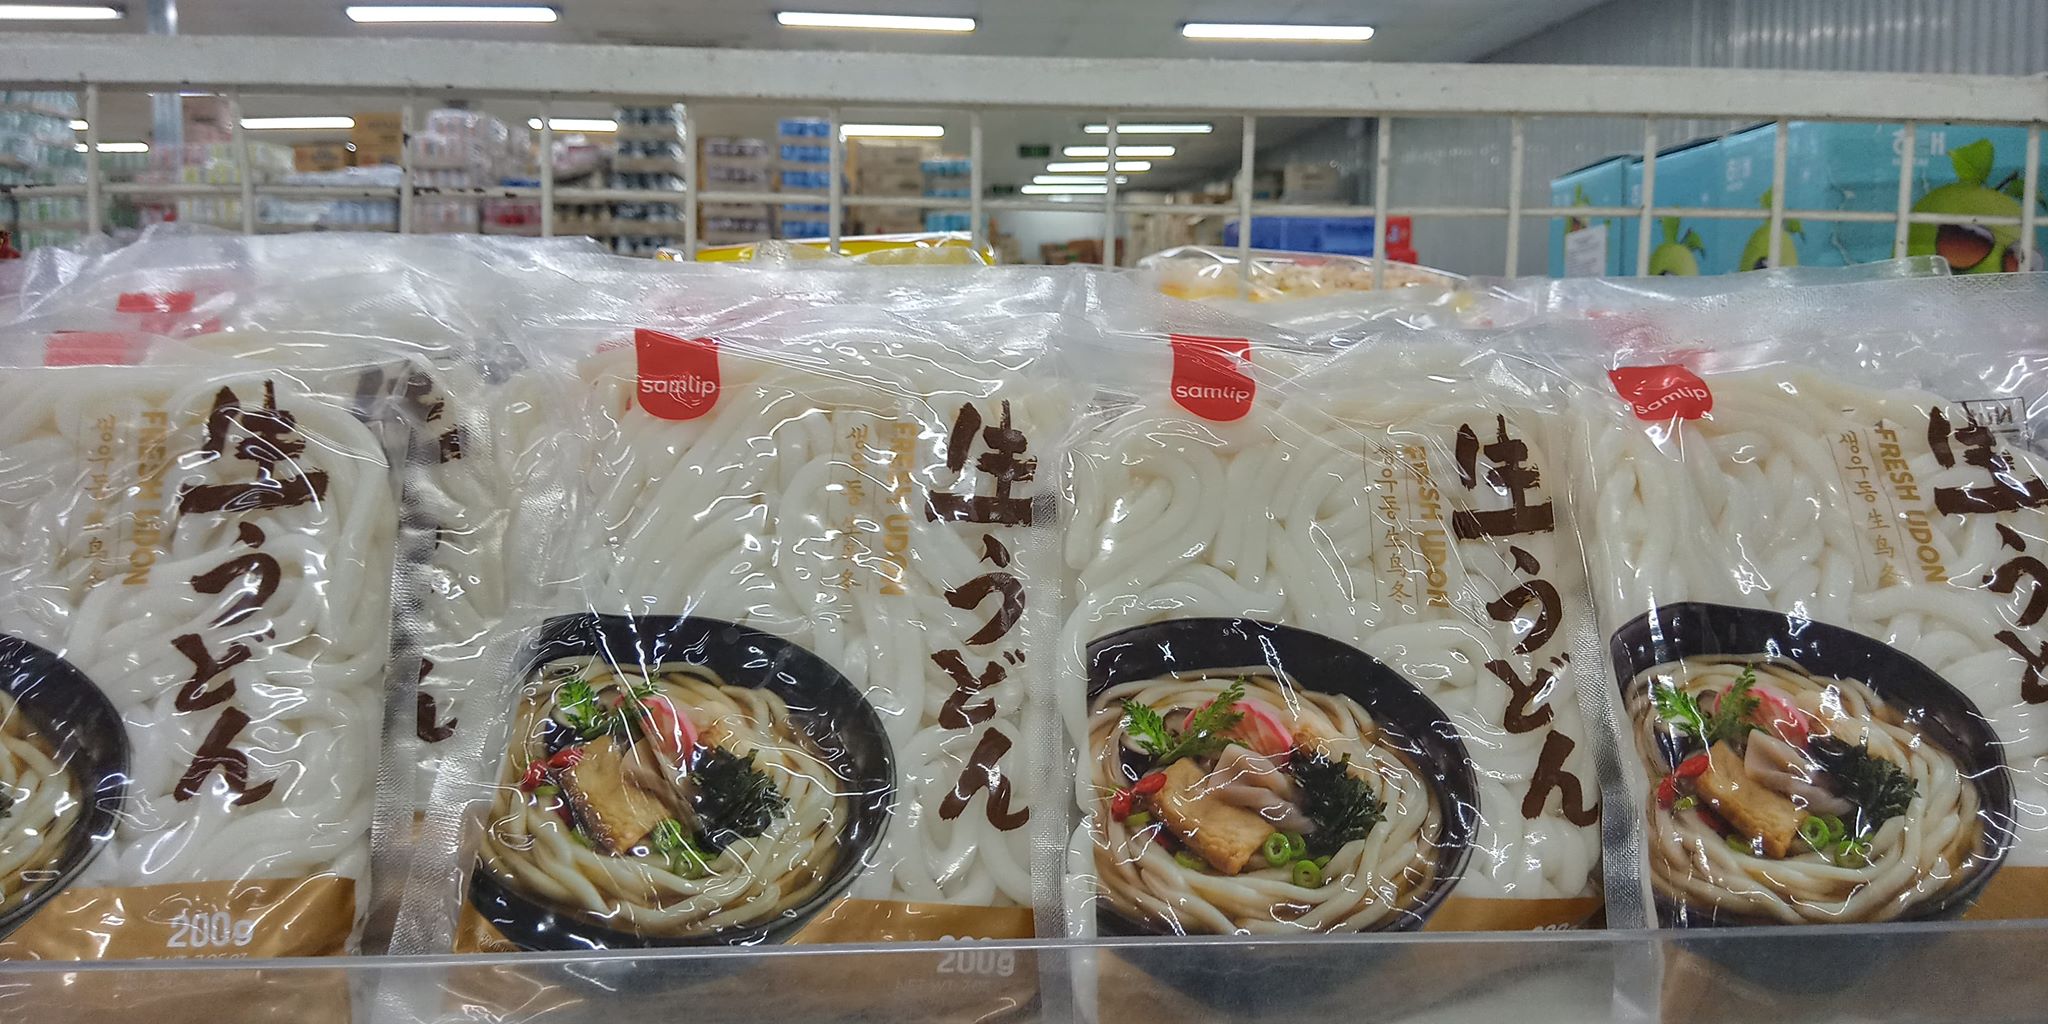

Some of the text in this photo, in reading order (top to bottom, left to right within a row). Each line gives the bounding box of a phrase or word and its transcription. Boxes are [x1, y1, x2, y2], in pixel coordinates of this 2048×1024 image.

[640, 375, 717, 398] samlip
[1175, 385, 1250, 403] samlip
[1635, 386, 1708, 415] samlip
[1875, 422, 1949, 584] FRESH UDON
[1404, 446, 1450, 608] FRSH UDON
[879, 514, 912, 596] UDON
[166, 908, 255, 948] 200g
[937, 935, 1016, 977] 200g
